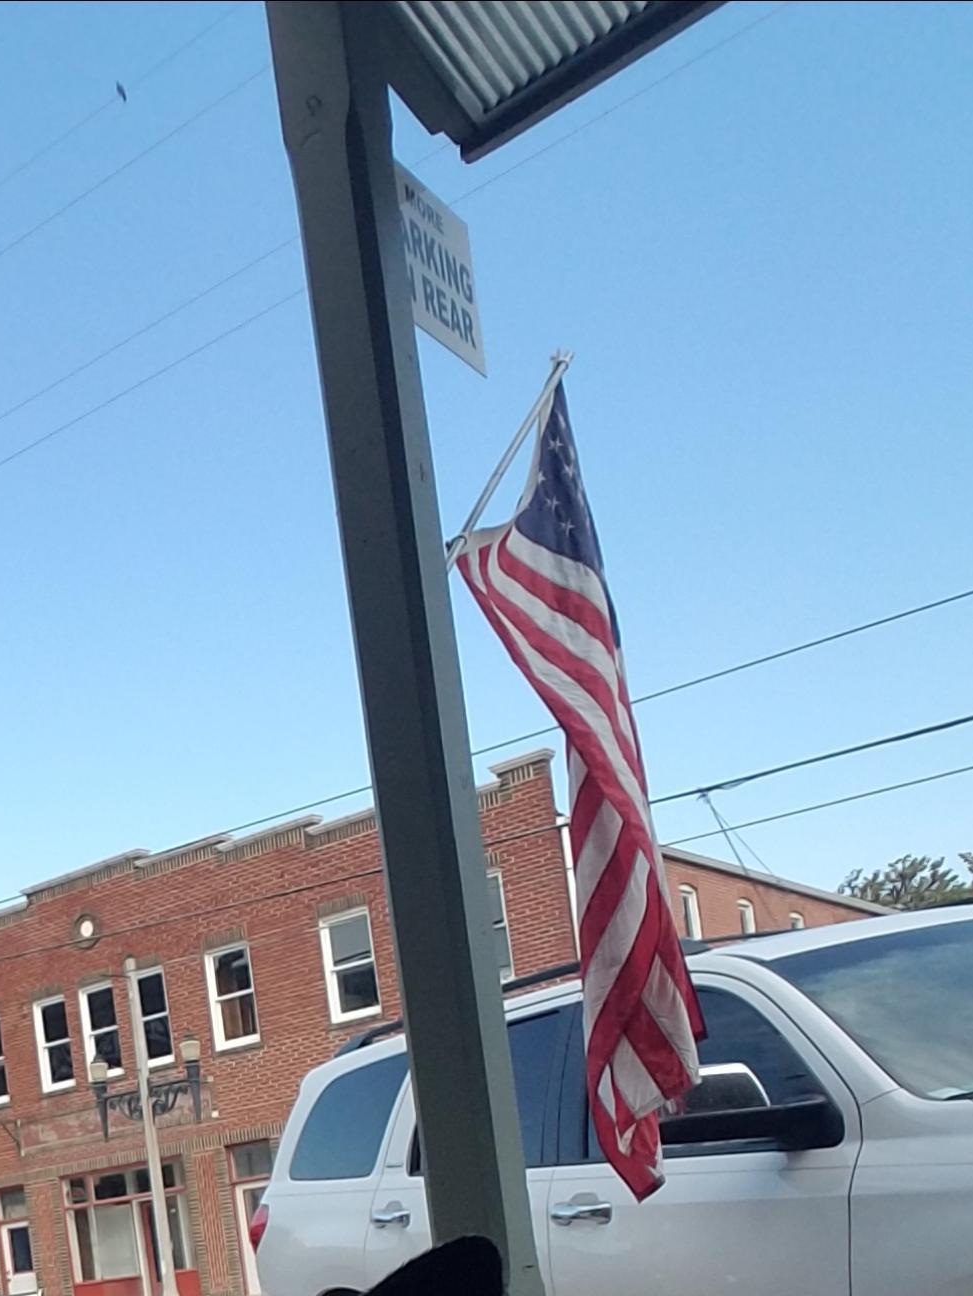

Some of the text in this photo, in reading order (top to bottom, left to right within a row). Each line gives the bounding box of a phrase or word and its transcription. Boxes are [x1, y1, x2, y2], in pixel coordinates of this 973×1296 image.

[404, 184, 444, 234] MORE
[402, 217, 474, 304] ARKING
[422, 273, 476, 350] REAR
